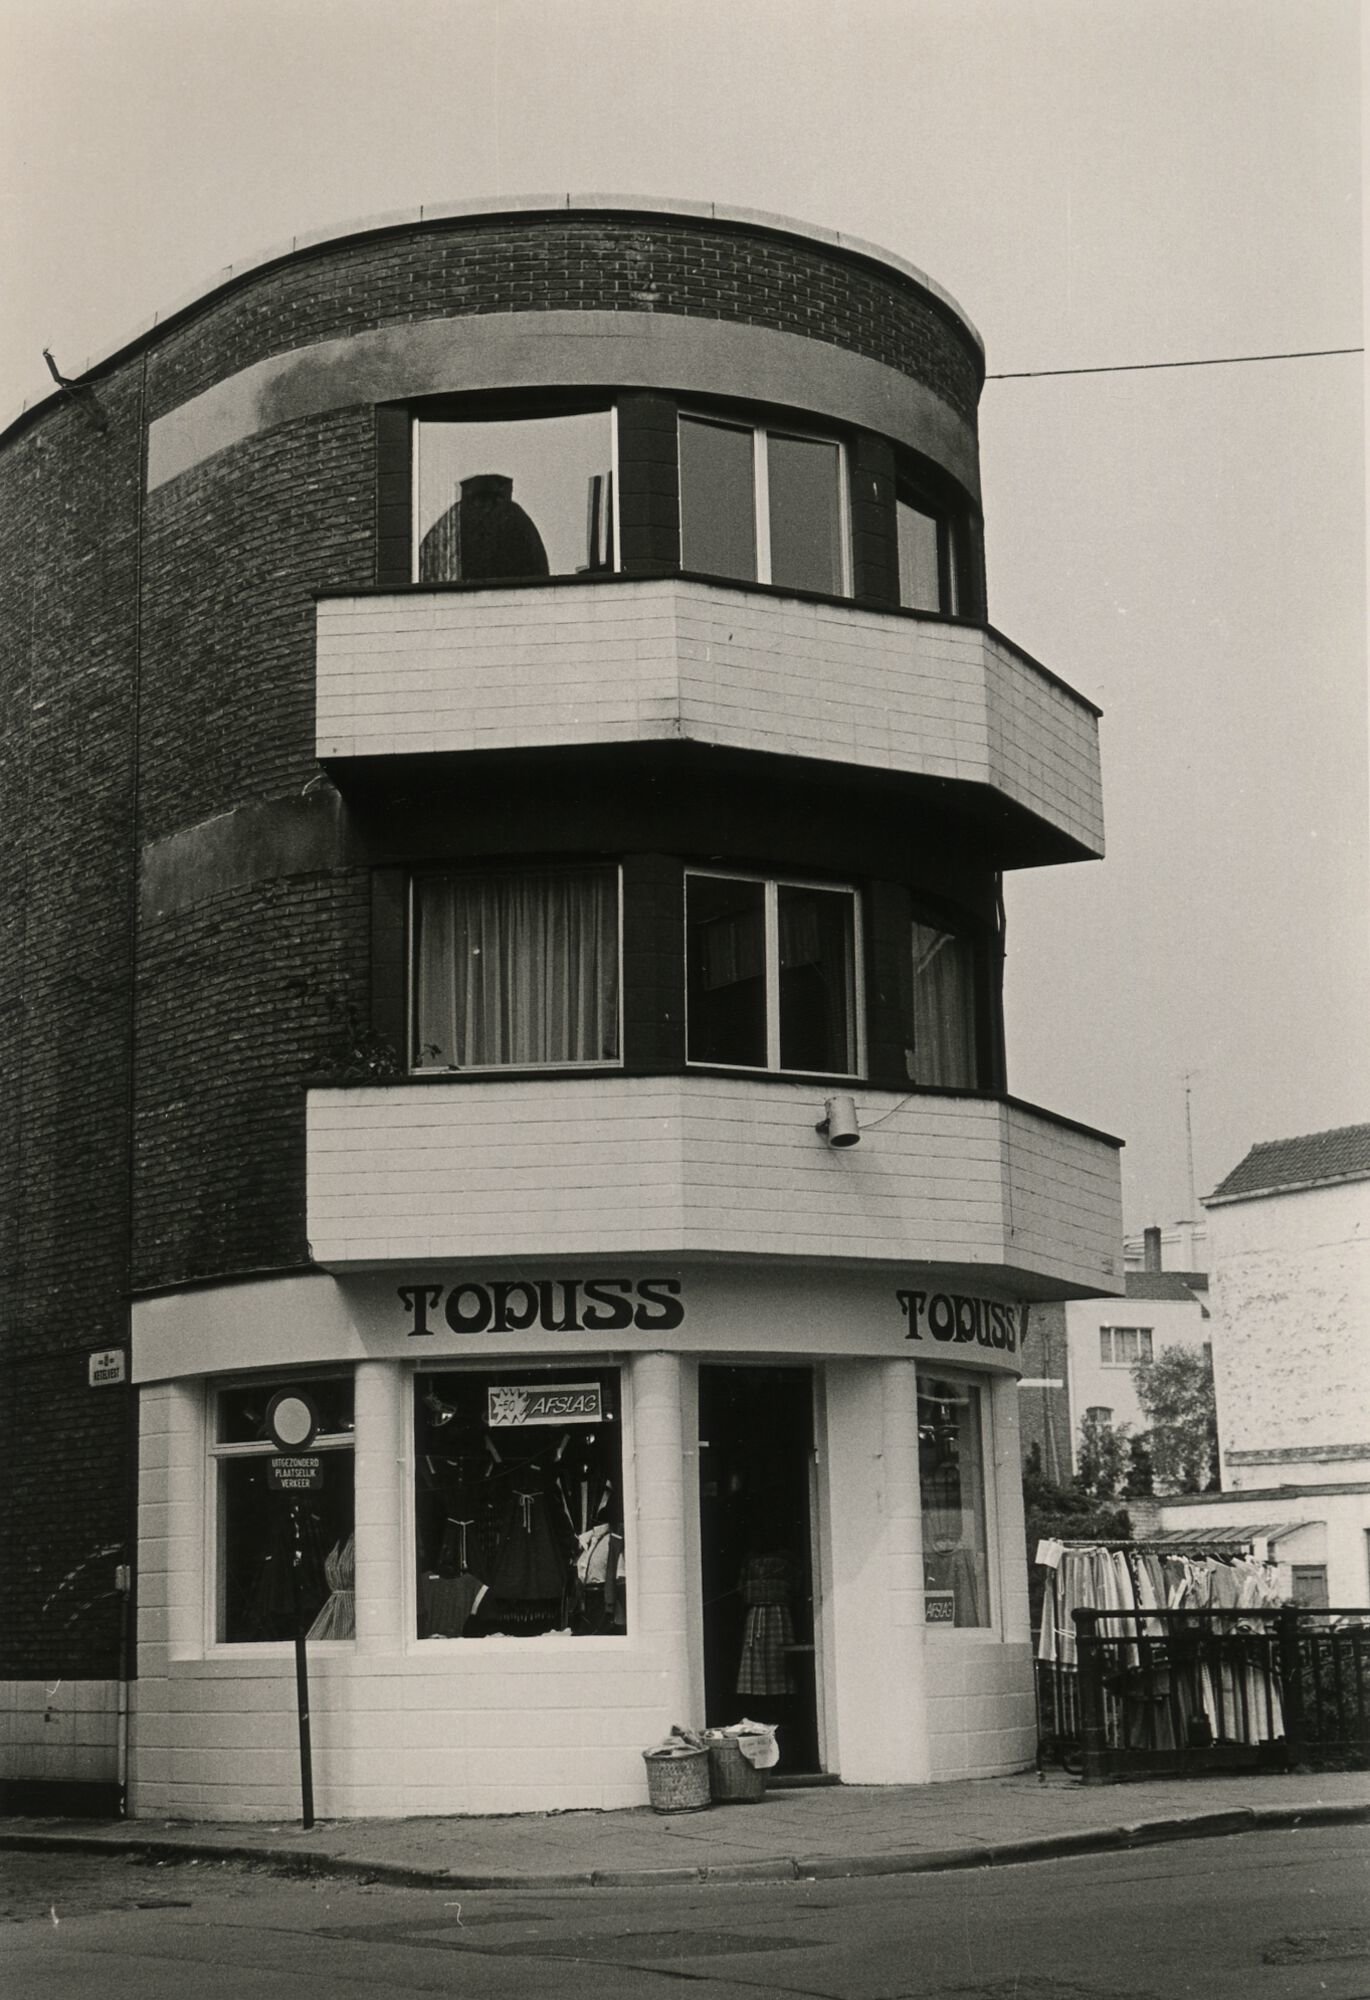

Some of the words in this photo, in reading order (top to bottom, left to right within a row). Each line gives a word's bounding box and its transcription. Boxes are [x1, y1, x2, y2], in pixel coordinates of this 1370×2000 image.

[397, 1279, 685, 1337] TOPUSS
[896, 1289, 1016, 1353] TOPUSS
[530, 1395, 596, 1414] AFSLAG
[271, 1458, 319, 1468] UITGEZONDERD
[275, 1468, 316, 1478] PLAATSELIJK
[281, 1478, 311, 1488] VERKEER
[927, 1602, 952, 1618] AFSLAG
